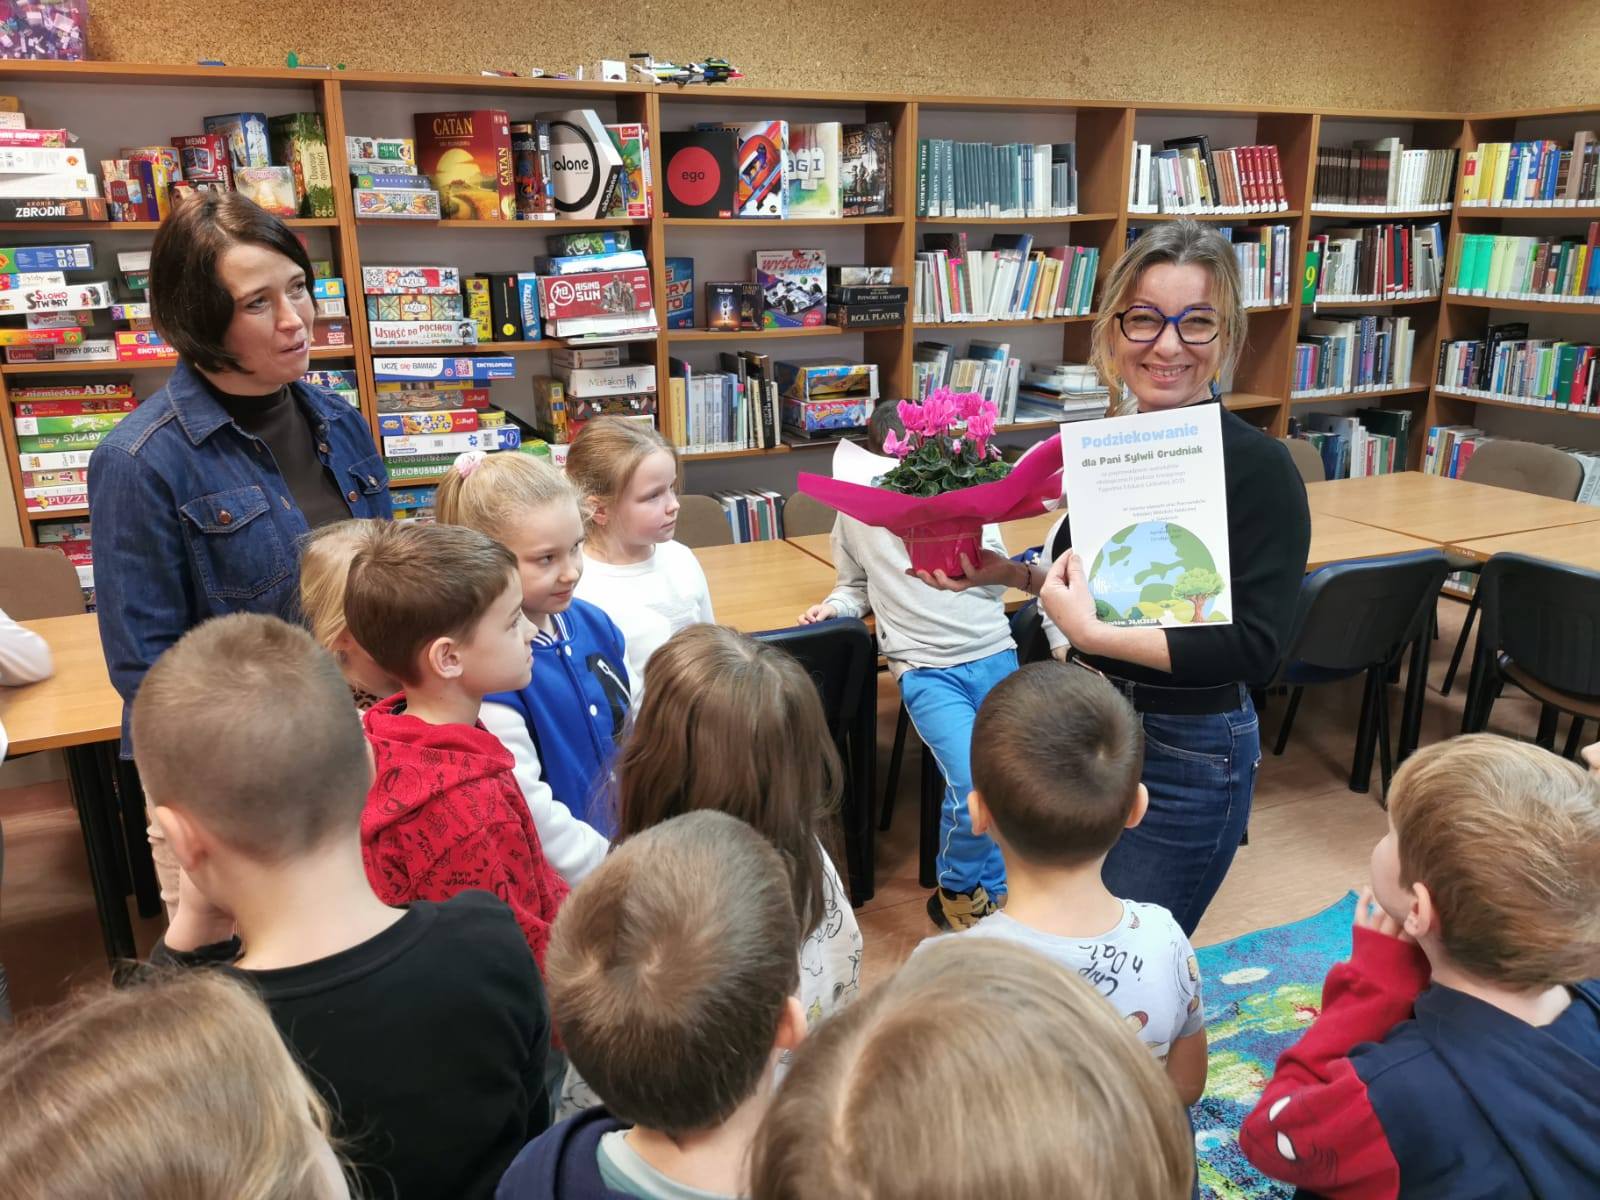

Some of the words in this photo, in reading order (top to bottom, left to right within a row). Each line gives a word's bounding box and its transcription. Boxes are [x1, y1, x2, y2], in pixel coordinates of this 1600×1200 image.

[433, 118, 473, 136] CATAN
[185, 136, 207, 145] MEMO
[498, 147, 509, 186] CATAN
[553, 155, 589, 171] alone
[682, 171, 705, 183] ego
[601, 173, 618, 213] abalone
[16, 205, 66, 218] ZBRODNI
[1305, 266, 1316, 288] 9
[575, 281, 600, 289] RISING
[576, 289, 601, 301] SUN
[851, 314, 871, 322] ROLL
[872, 312, 900, 321] PLAYER
[408, 328, 418, 336] DO
[84, 384, 116, 395] ABC
[63, 432, 101, 443] SYLABY
[1082, 456, 1096, 468] dla
[1100, 455, 1121, 466] Pani
[1124, 451, 1154, 464] Sylwii
[1157, 445, 1203, 459] Grudniak
